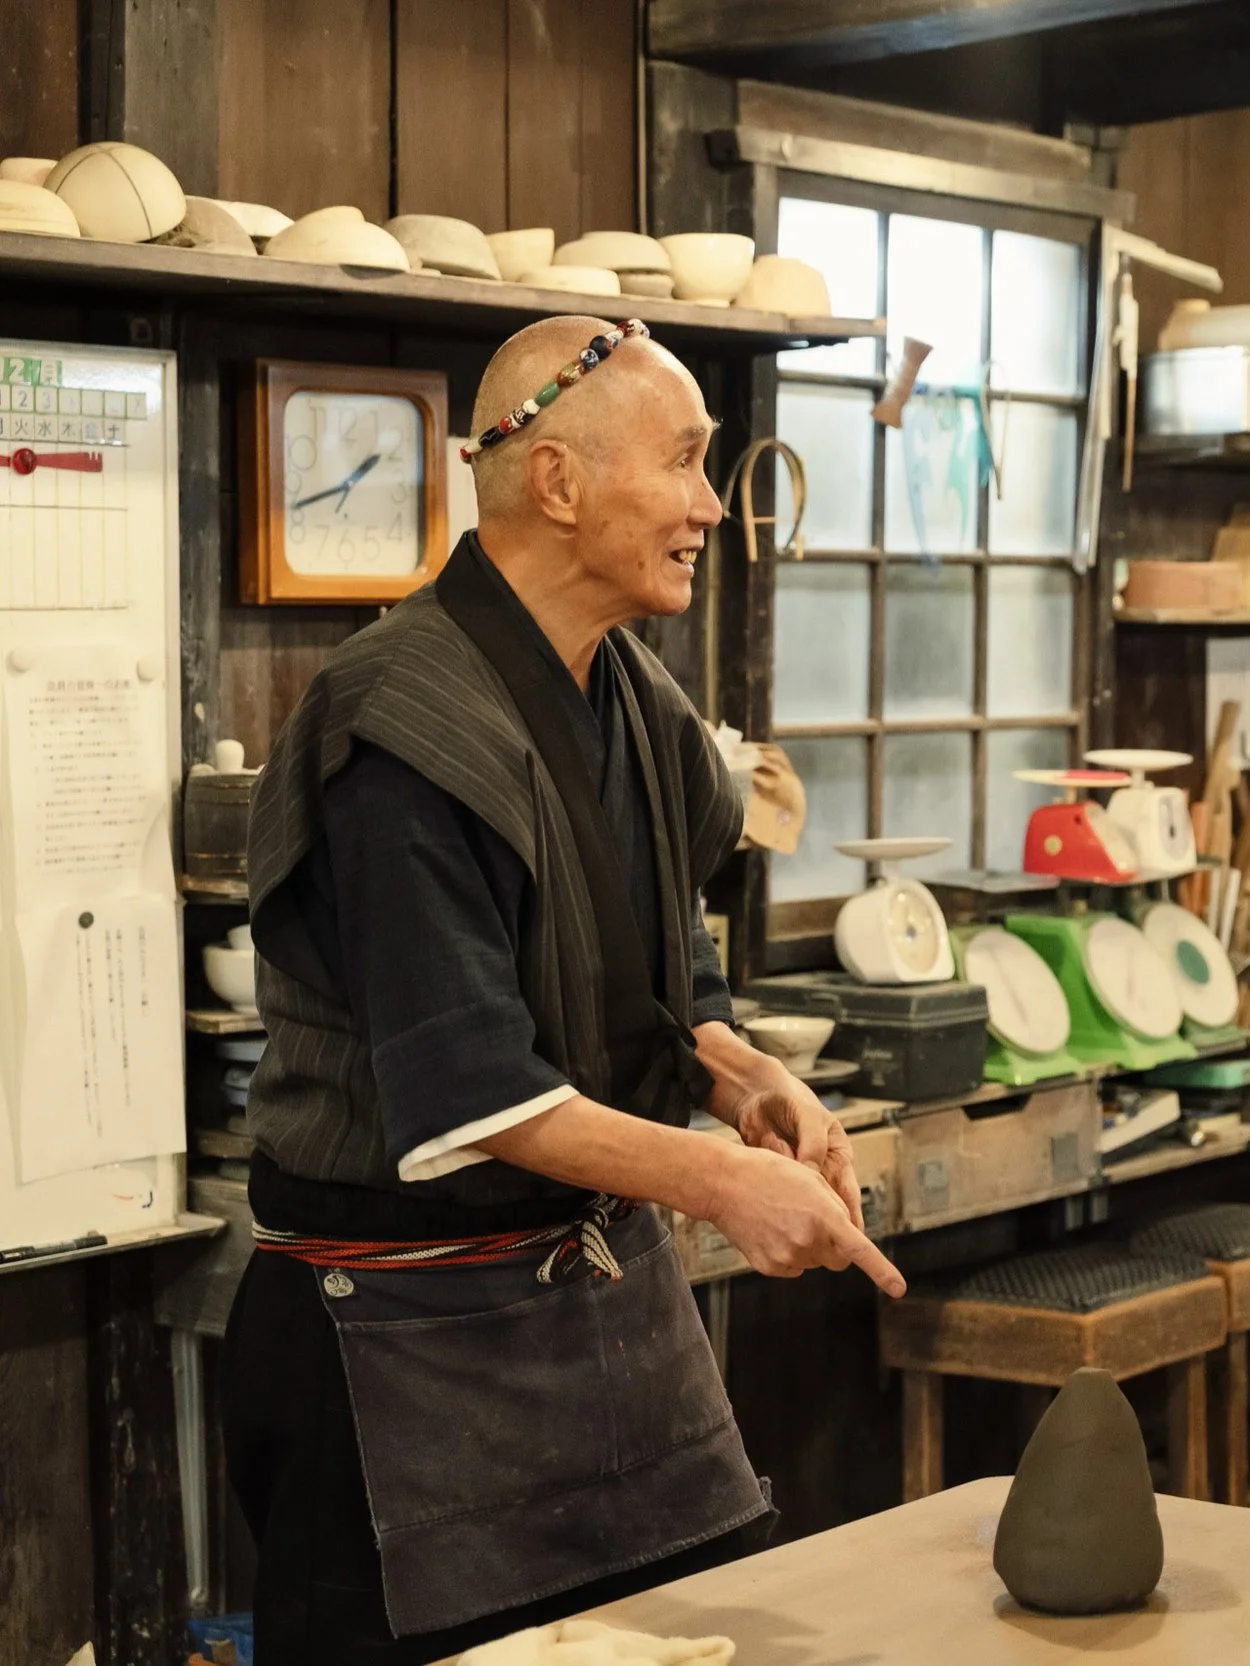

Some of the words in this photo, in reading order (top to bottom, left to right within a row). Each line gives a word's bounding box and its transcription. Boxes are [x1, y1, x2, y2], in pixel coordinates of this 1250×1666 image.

[18, 390, 28, 407] 2
[42, 390, 51, 409] 3
[15, 418, 28, 435] 火
[38, 420, 52, 437] 水
[62, 421, 76, 437] 木
[289, 510, 306, 544] 8
[316, 525, 330, 557] 7
[363, 525, 381, 561] 5
[386, 511, 403, 543] 4
[337, 528, 355, 563] 6
